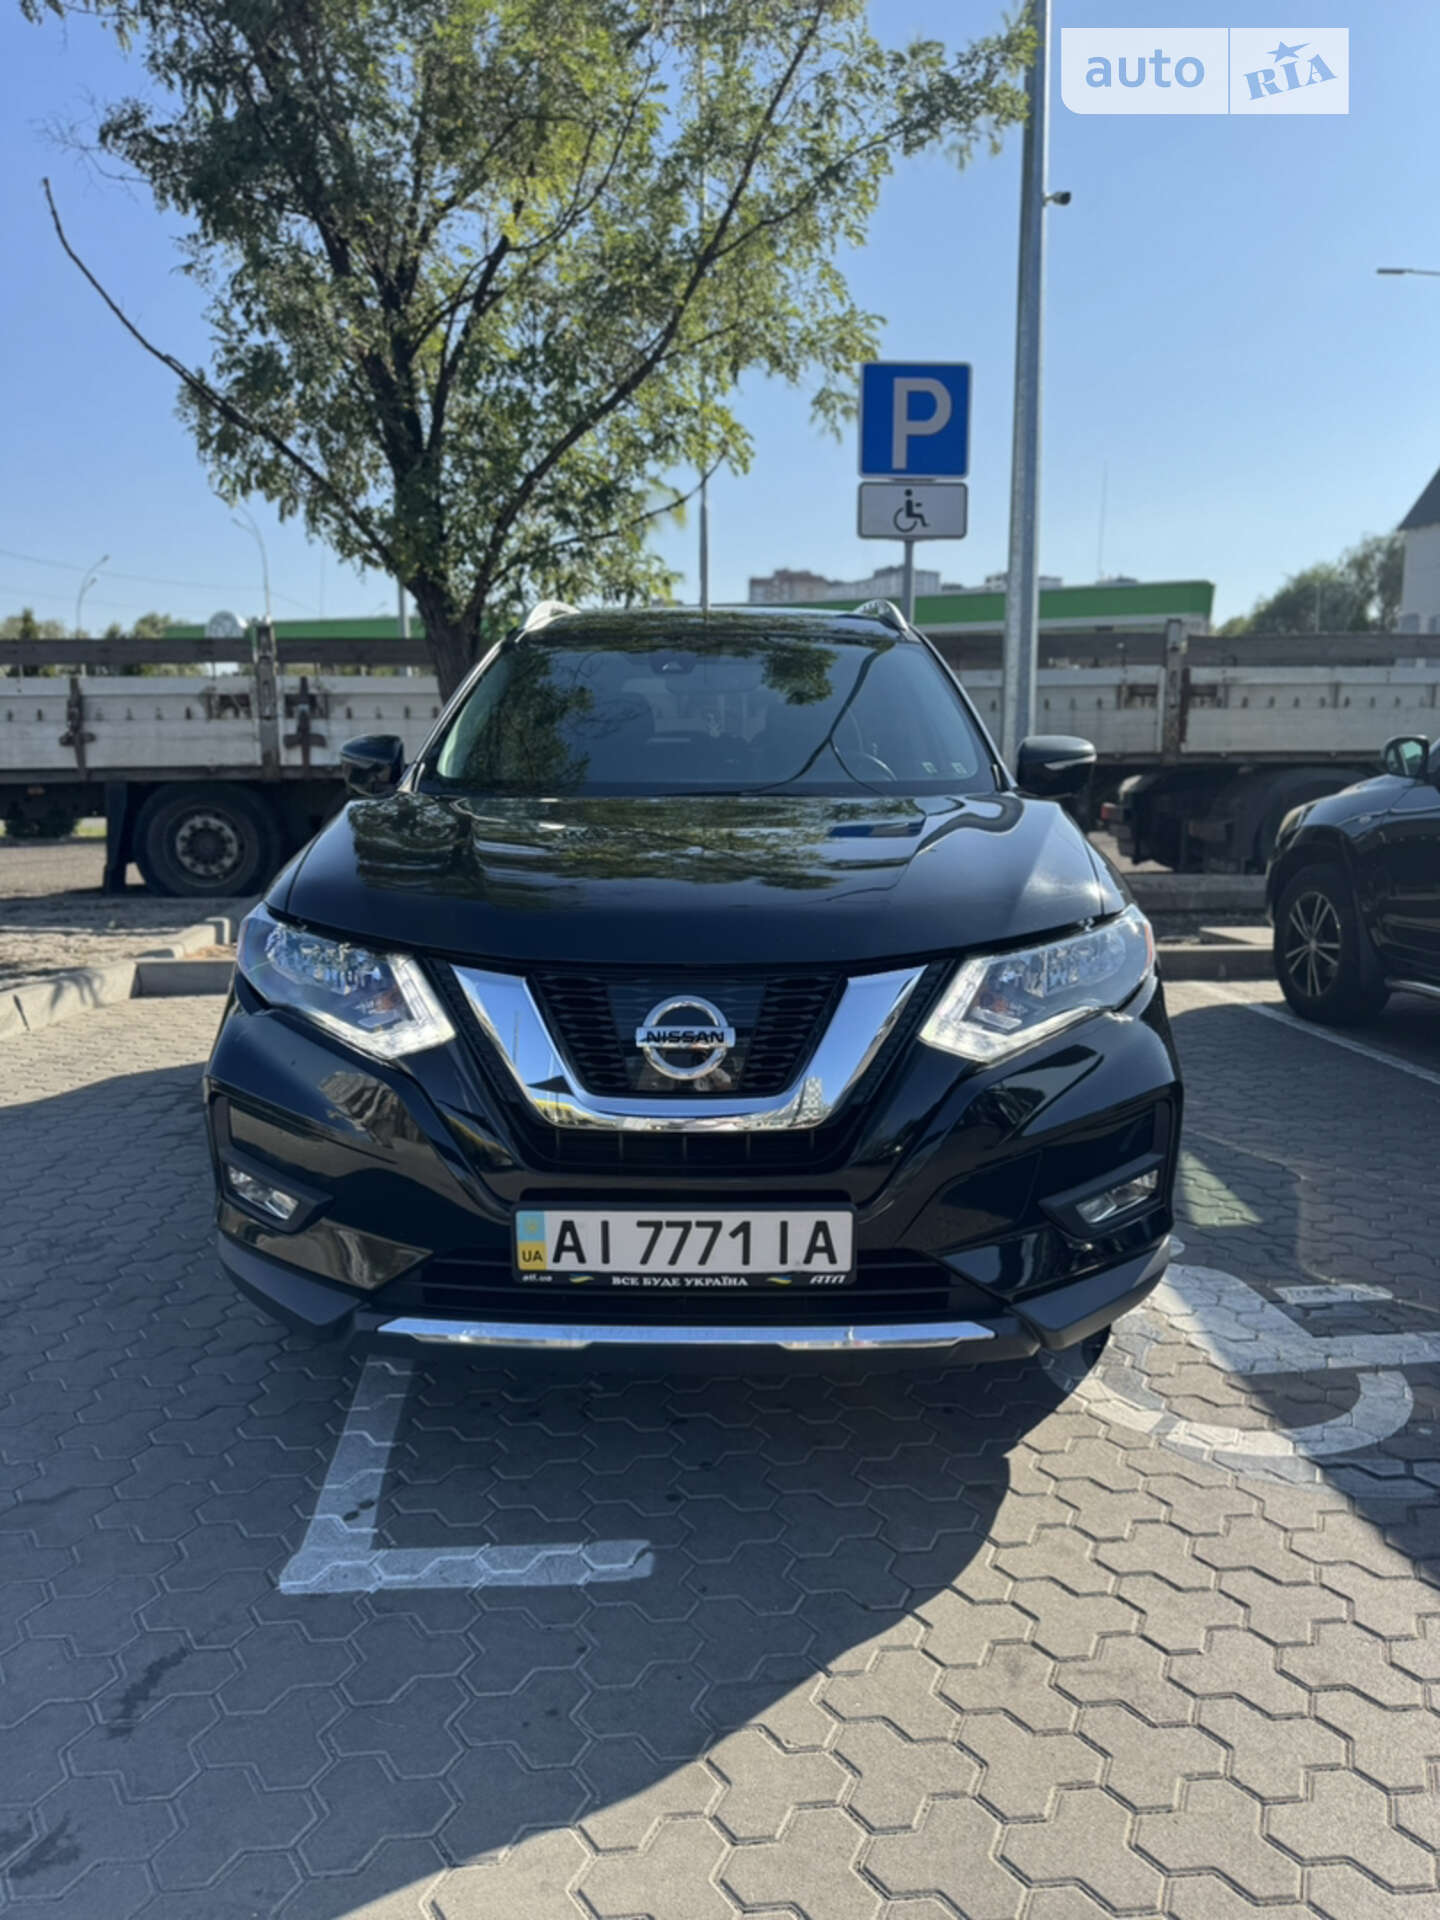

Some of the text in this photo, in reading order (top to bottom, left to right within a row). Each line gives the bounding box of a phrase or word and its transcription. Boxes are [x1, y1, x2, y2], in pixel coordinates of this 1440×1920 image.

[891, 377, 952, 470] P
[645, 1030, 725, 1043] NISSAN
[552, 1220, 838, 1266] AI 7771 IA
[522, 1250, 543, 1263] UA
[611, 1275, 749, 1287] ВСЕ БУДЕ УКРАЇНА
